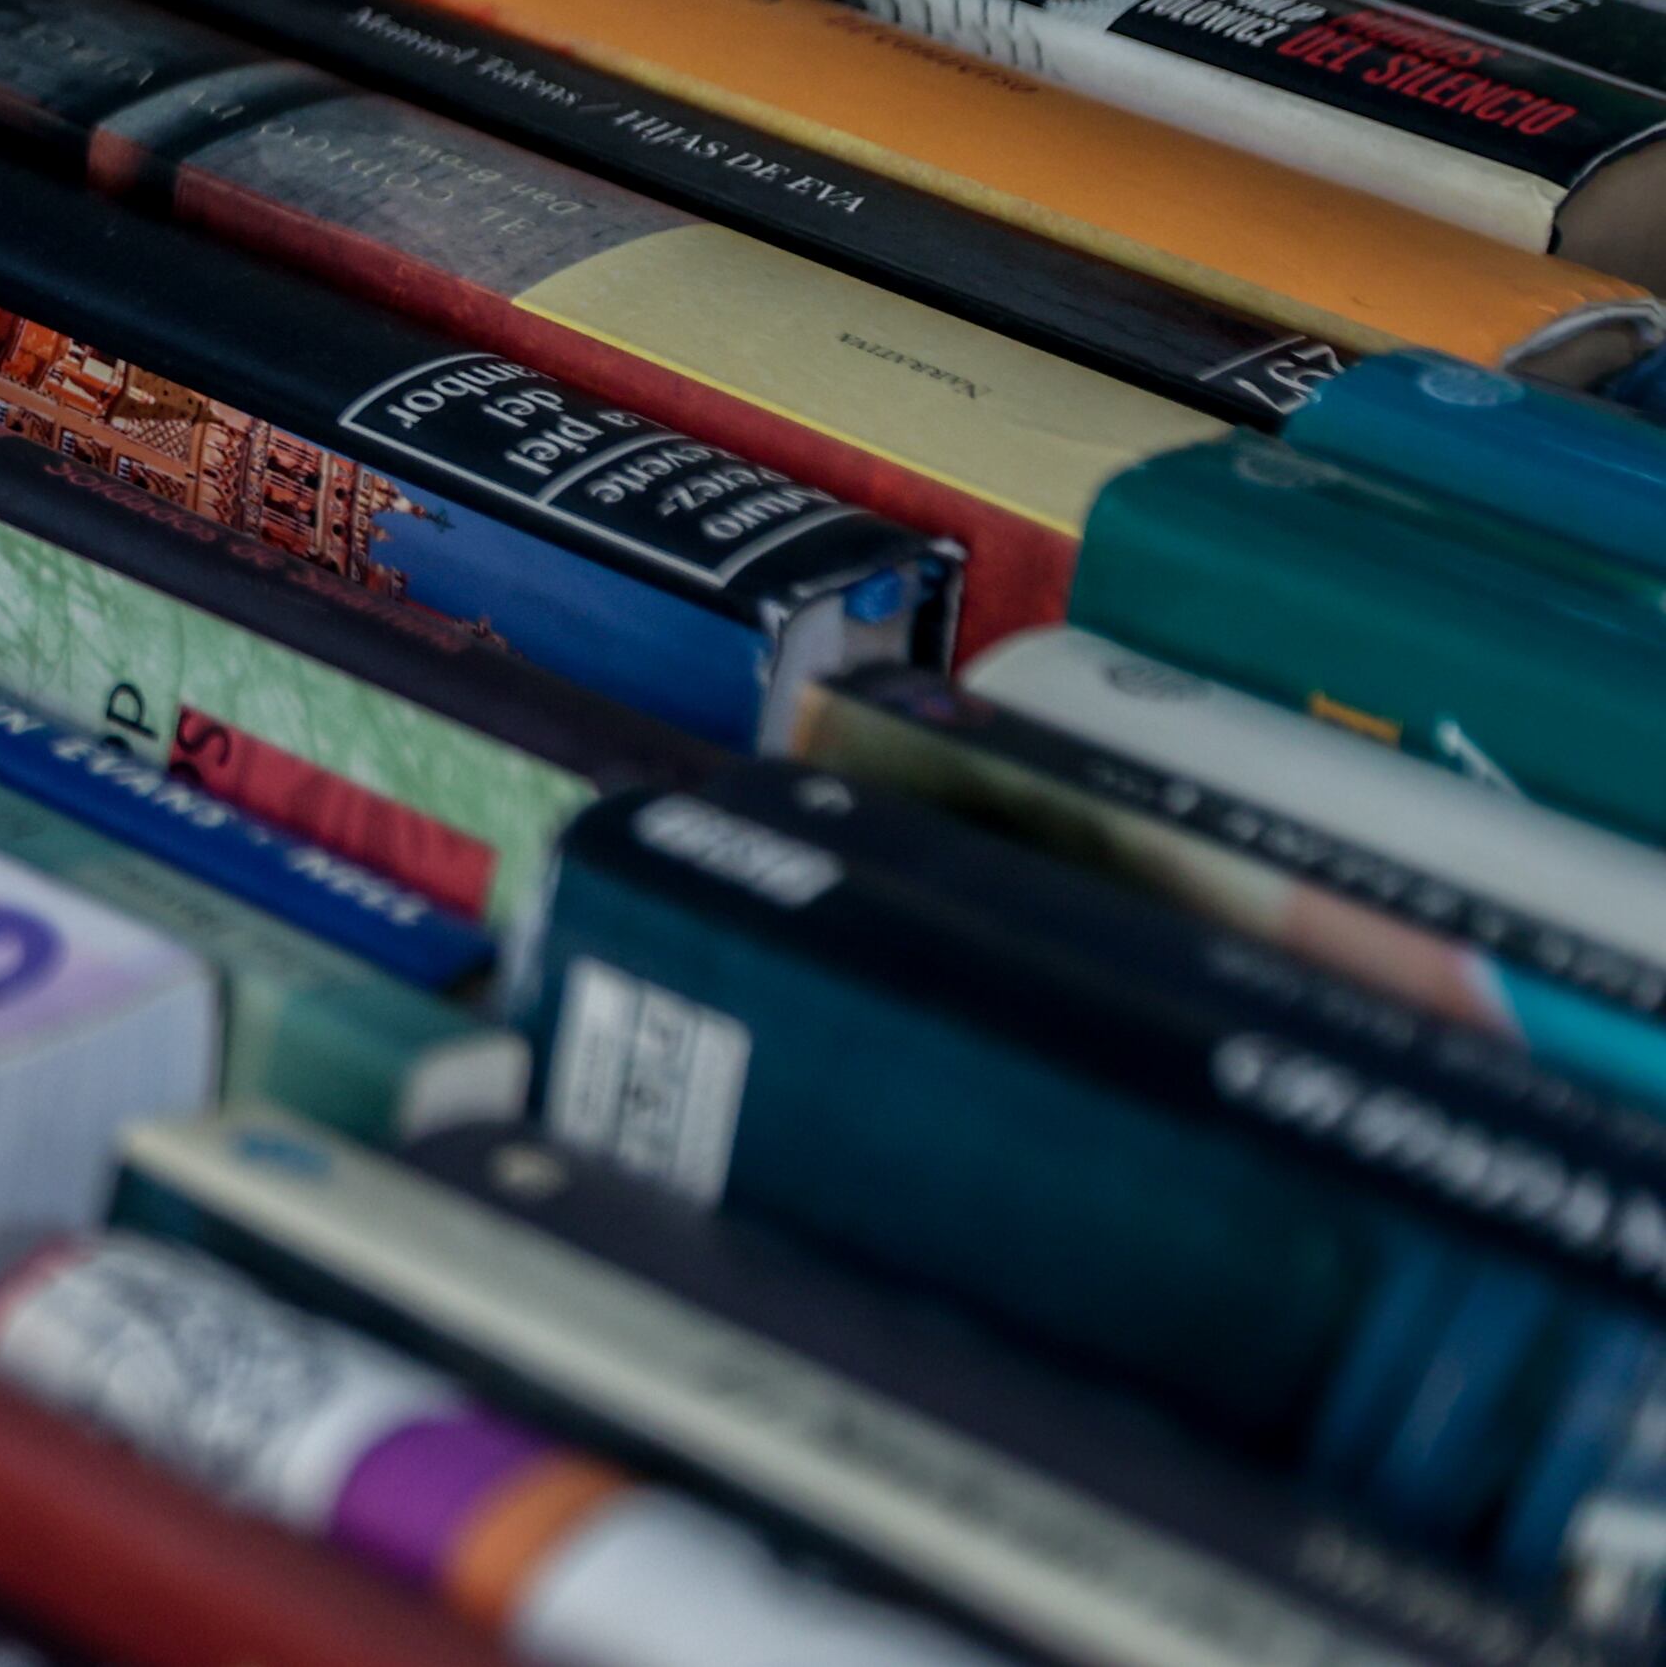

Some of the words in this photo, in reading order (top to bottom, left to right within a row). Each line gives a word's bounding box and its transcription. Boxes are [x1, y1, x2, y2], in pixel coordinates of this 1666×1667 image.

[1278, 24, 1370, 85] DEL
[1361, 47, 1576, 137] SILENCIO
[389, 134, 505, 187] Brown
[614, 106, 722, 158] HIJAS
[724, 153, 779, 184] DE
[776, 170, 868, 214] EVA
[511, 180, 583, 216] Dan
[483, 387, 567, 429] del
[503, 415, 608, 476] piel
[45, 459, 220, 545] Soldados
[51, 736, 241, 830] EVANS
